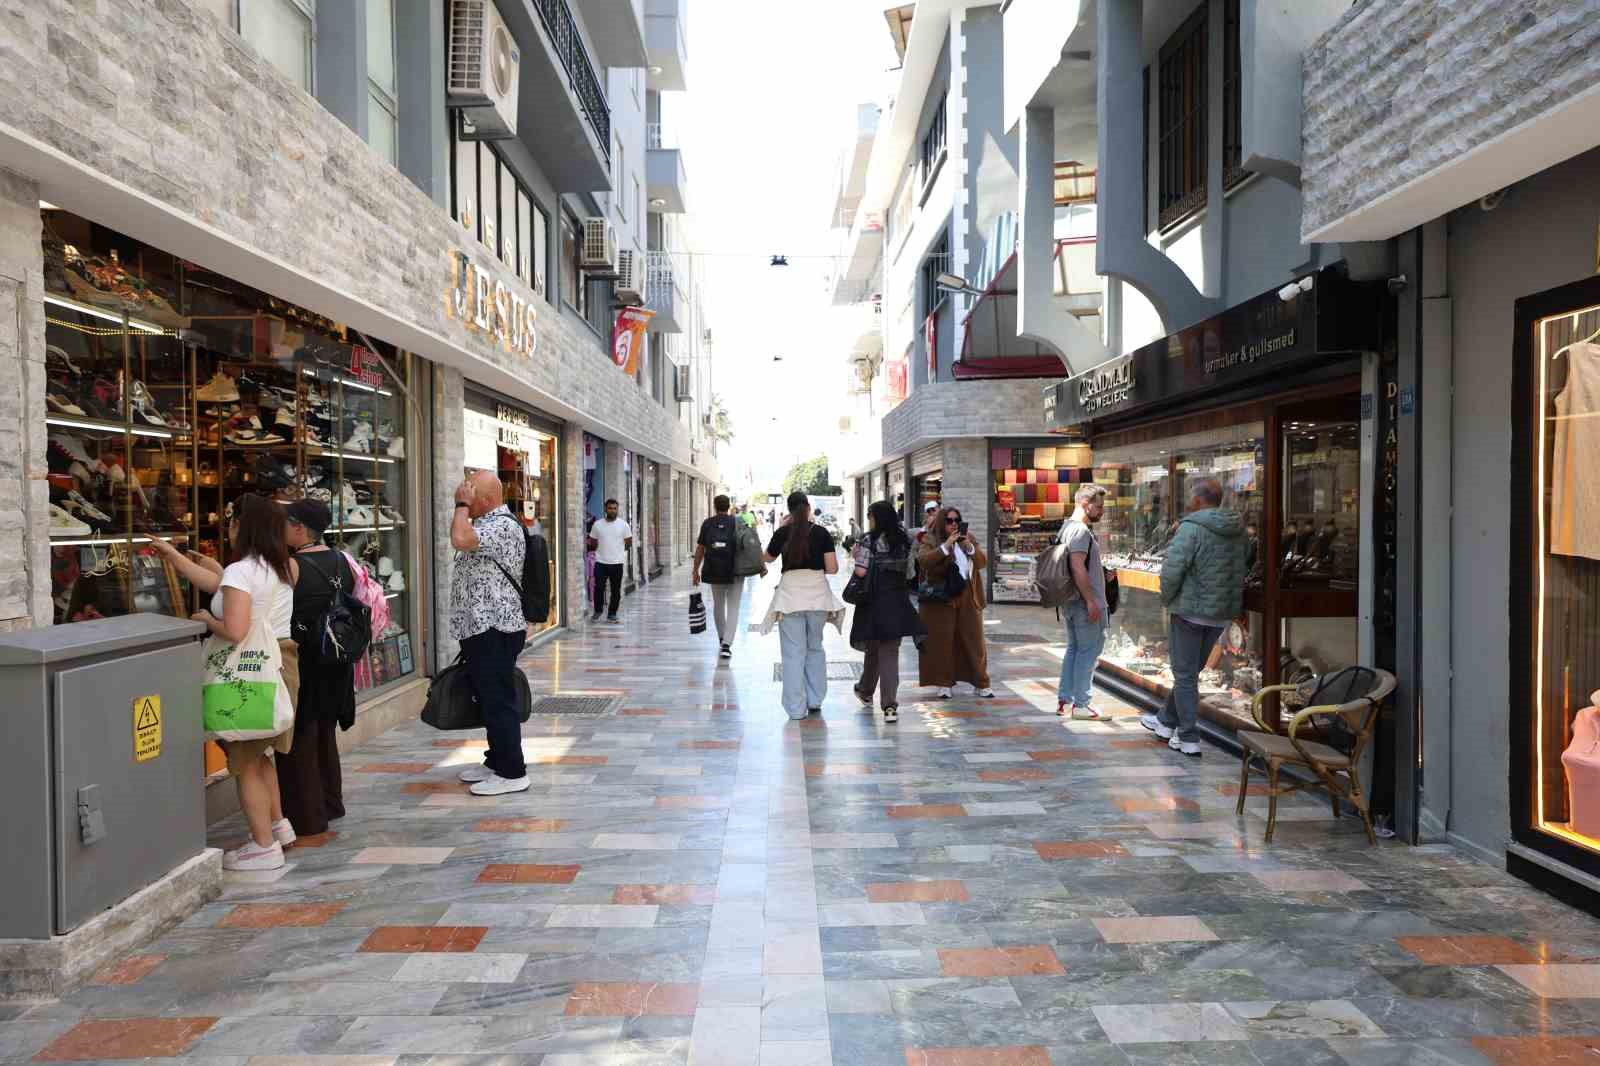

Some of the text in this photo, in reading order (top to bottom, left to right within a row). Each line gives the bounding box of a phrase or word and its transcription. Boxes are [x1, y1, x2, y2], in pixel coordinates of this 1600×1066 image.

[461, 196, 544, 296] JESUS
[445, 249, 537, 358] JESUS
[1249, 327, 1295, 363] gullsmed
[237, 663, 261, 672] GREEN
